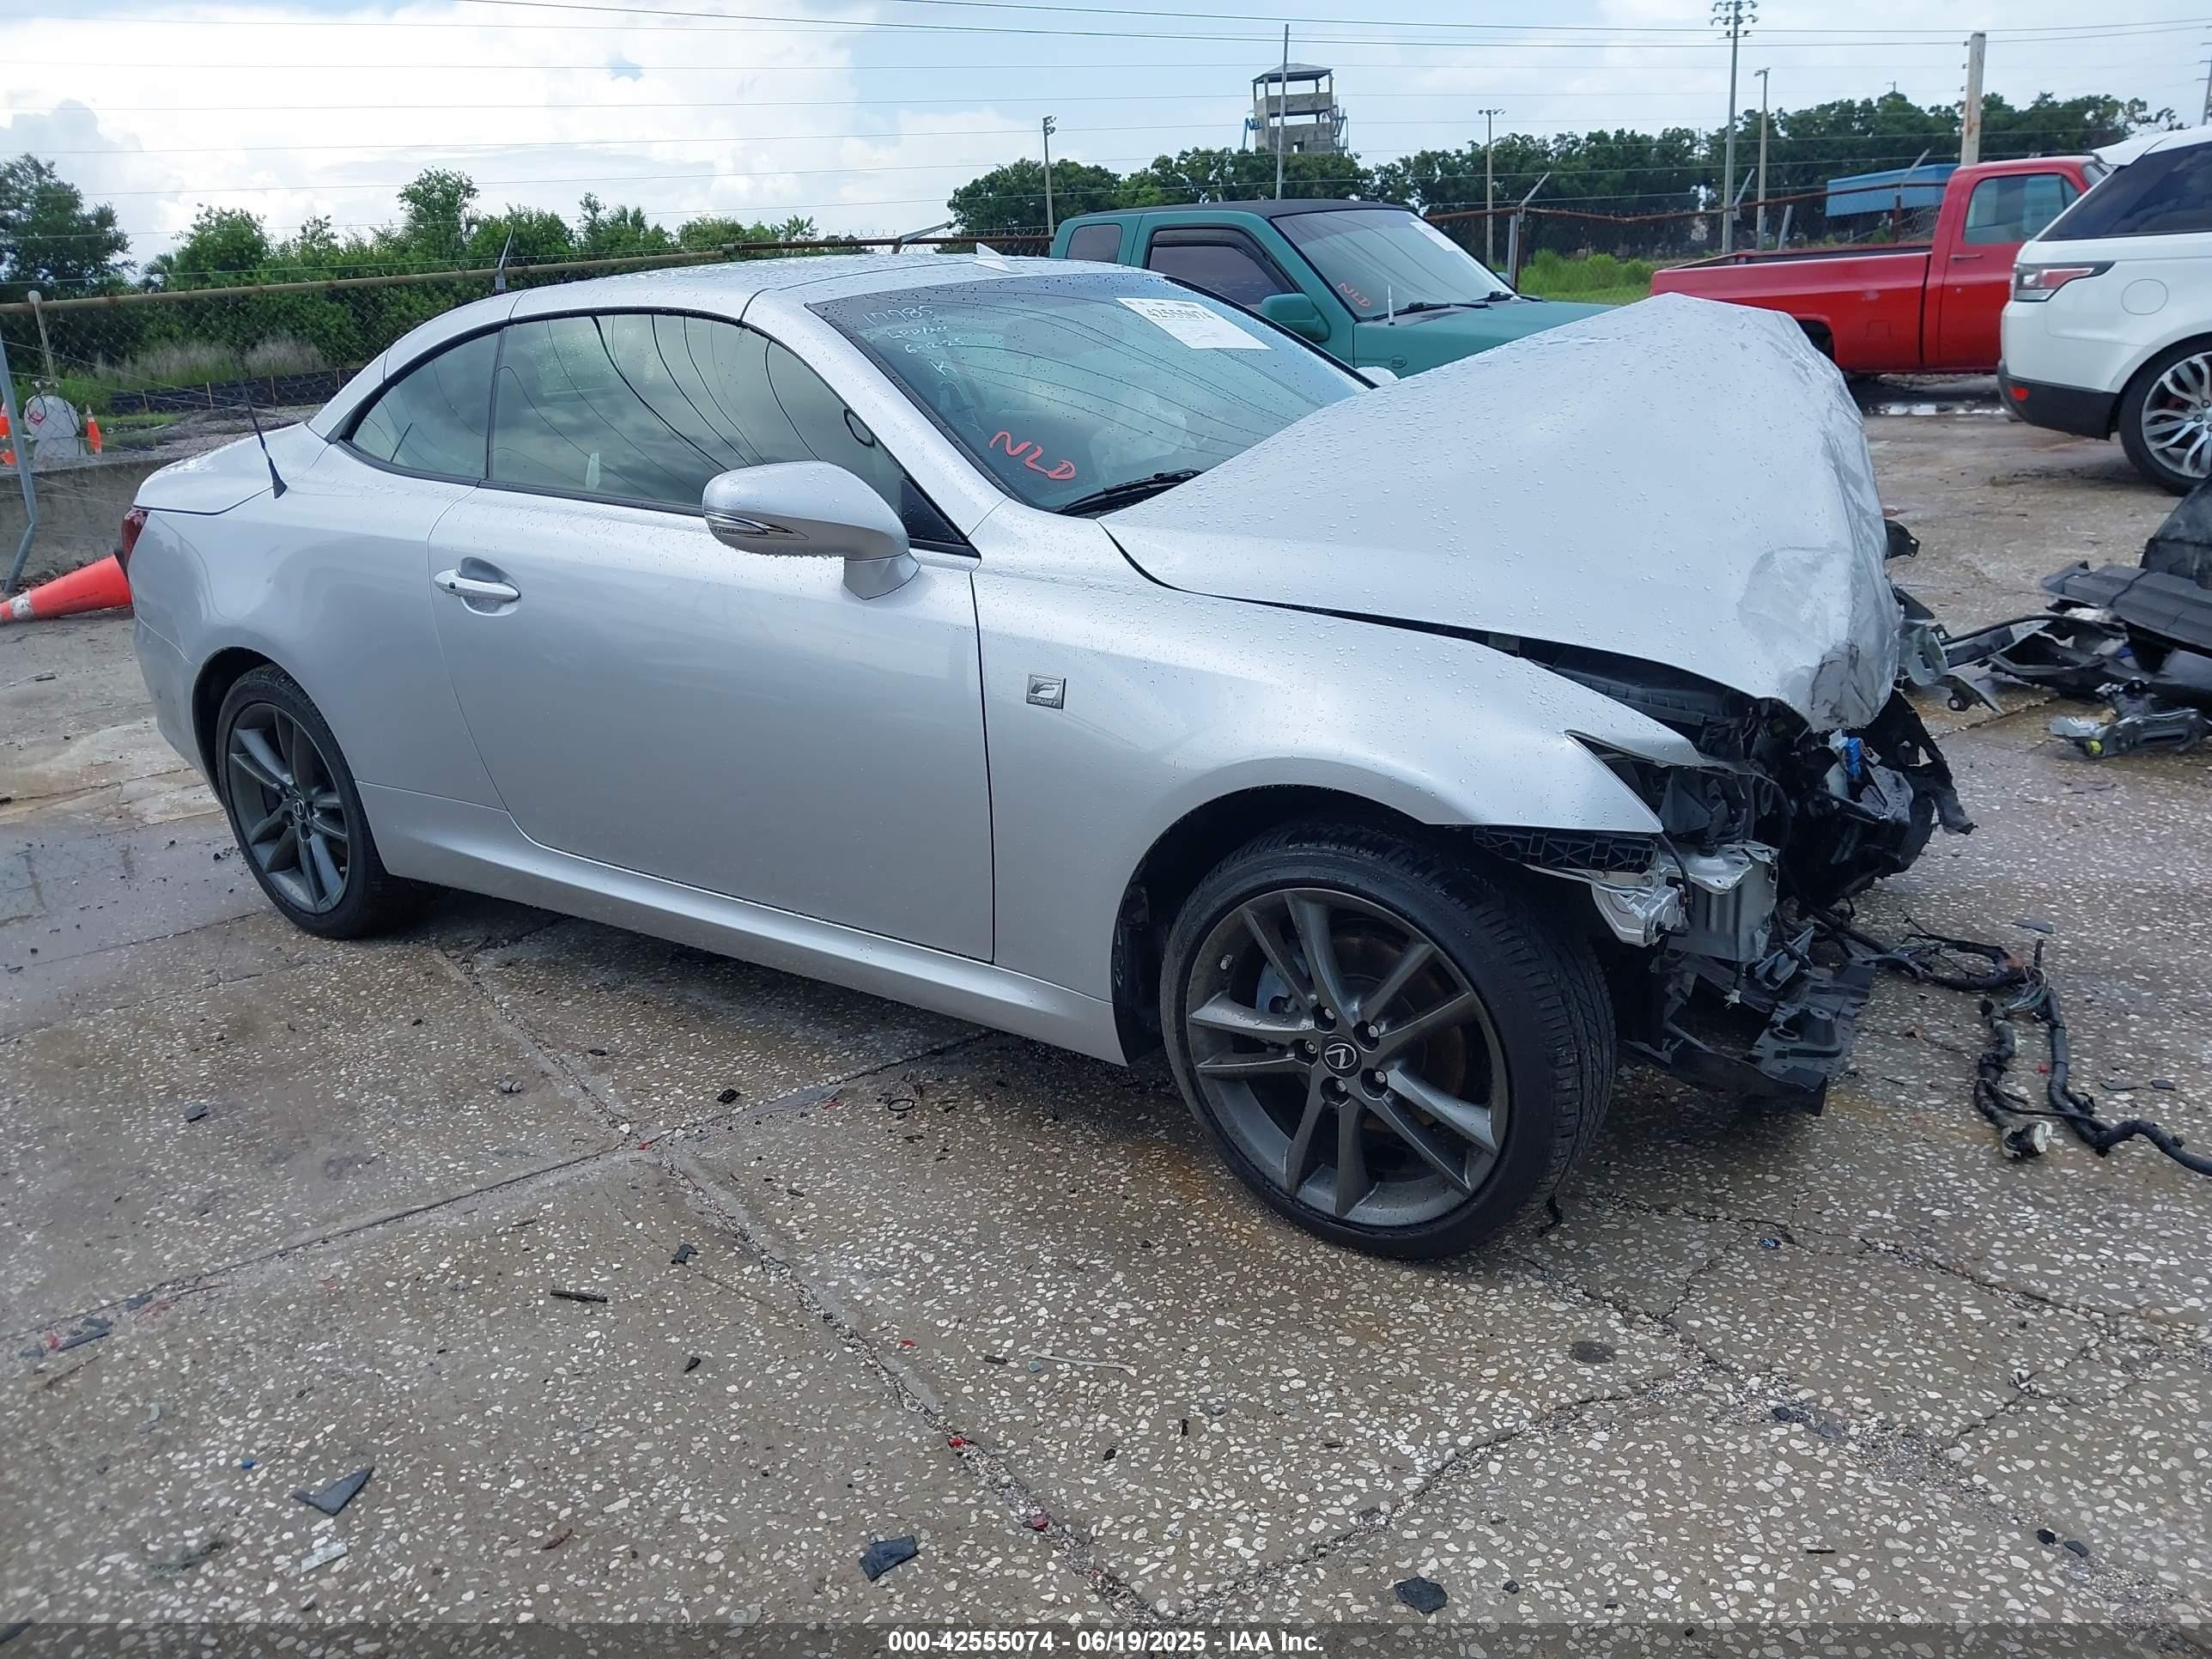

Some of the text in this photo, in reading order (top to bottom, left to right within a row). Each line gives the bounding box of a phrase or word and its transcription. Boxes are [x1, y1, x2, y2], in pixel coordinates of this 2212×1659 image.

[1338, 283, 1370, 307] NLD
[988, 430, 1077, 480] NLD
[1030, 697, 1058, 707] SPORT
